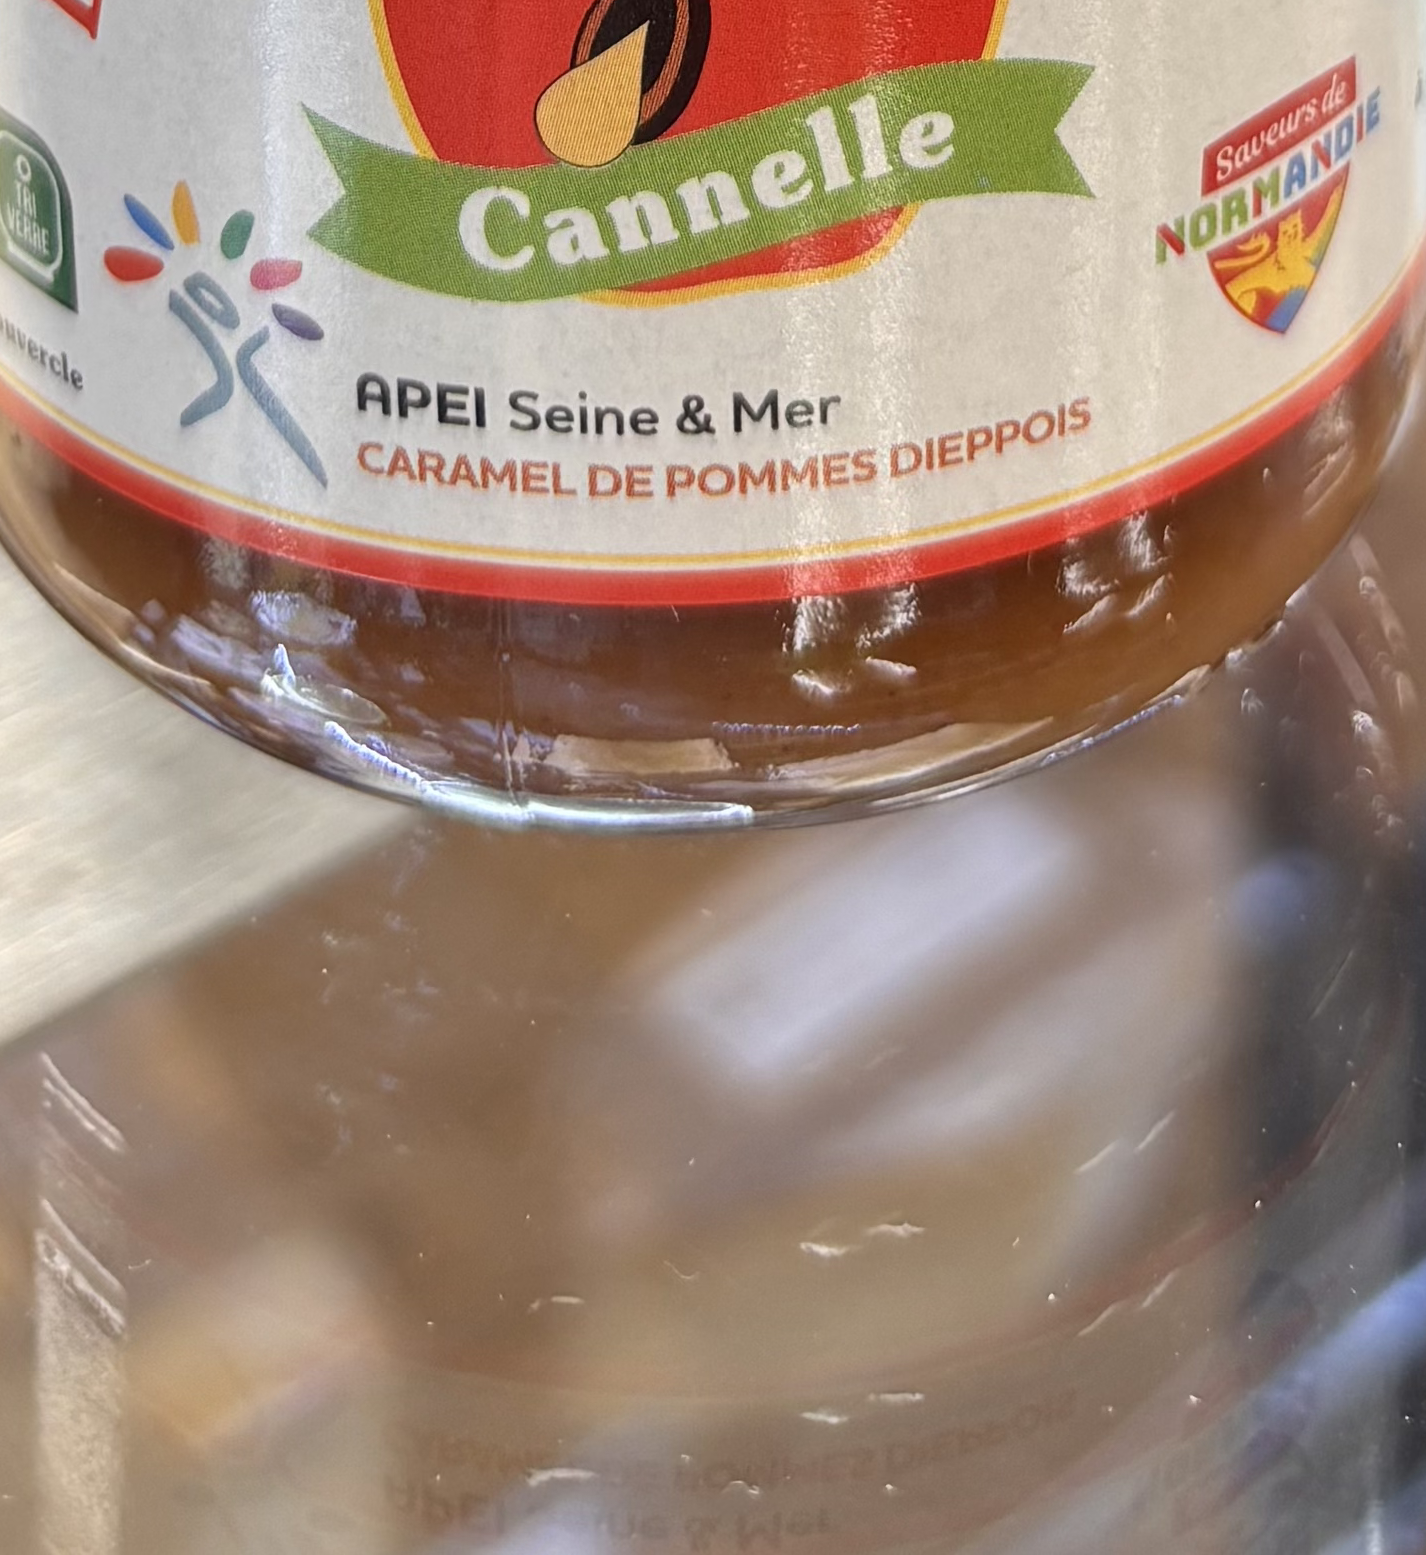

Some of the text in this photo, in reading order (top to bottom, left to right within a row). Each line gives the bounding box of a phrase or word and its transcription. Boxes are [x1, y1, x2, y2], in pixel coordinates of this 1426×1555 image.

[1155, 85, 1381, 265] NORMANDIE
[1215, 95, 1318, 182] Saveurs
[1321, 72, 1347, 115] de
[6, 201, 50, 256] VERRE
[14, 180, 38, 219] TRI
[457, 94, 955, 272] Cannelle
[356, 371, 842, 436] APEI Seine & Mer
[356, 396, 1092, 498] CARAMEL DE POMMES DIEPPOIS
